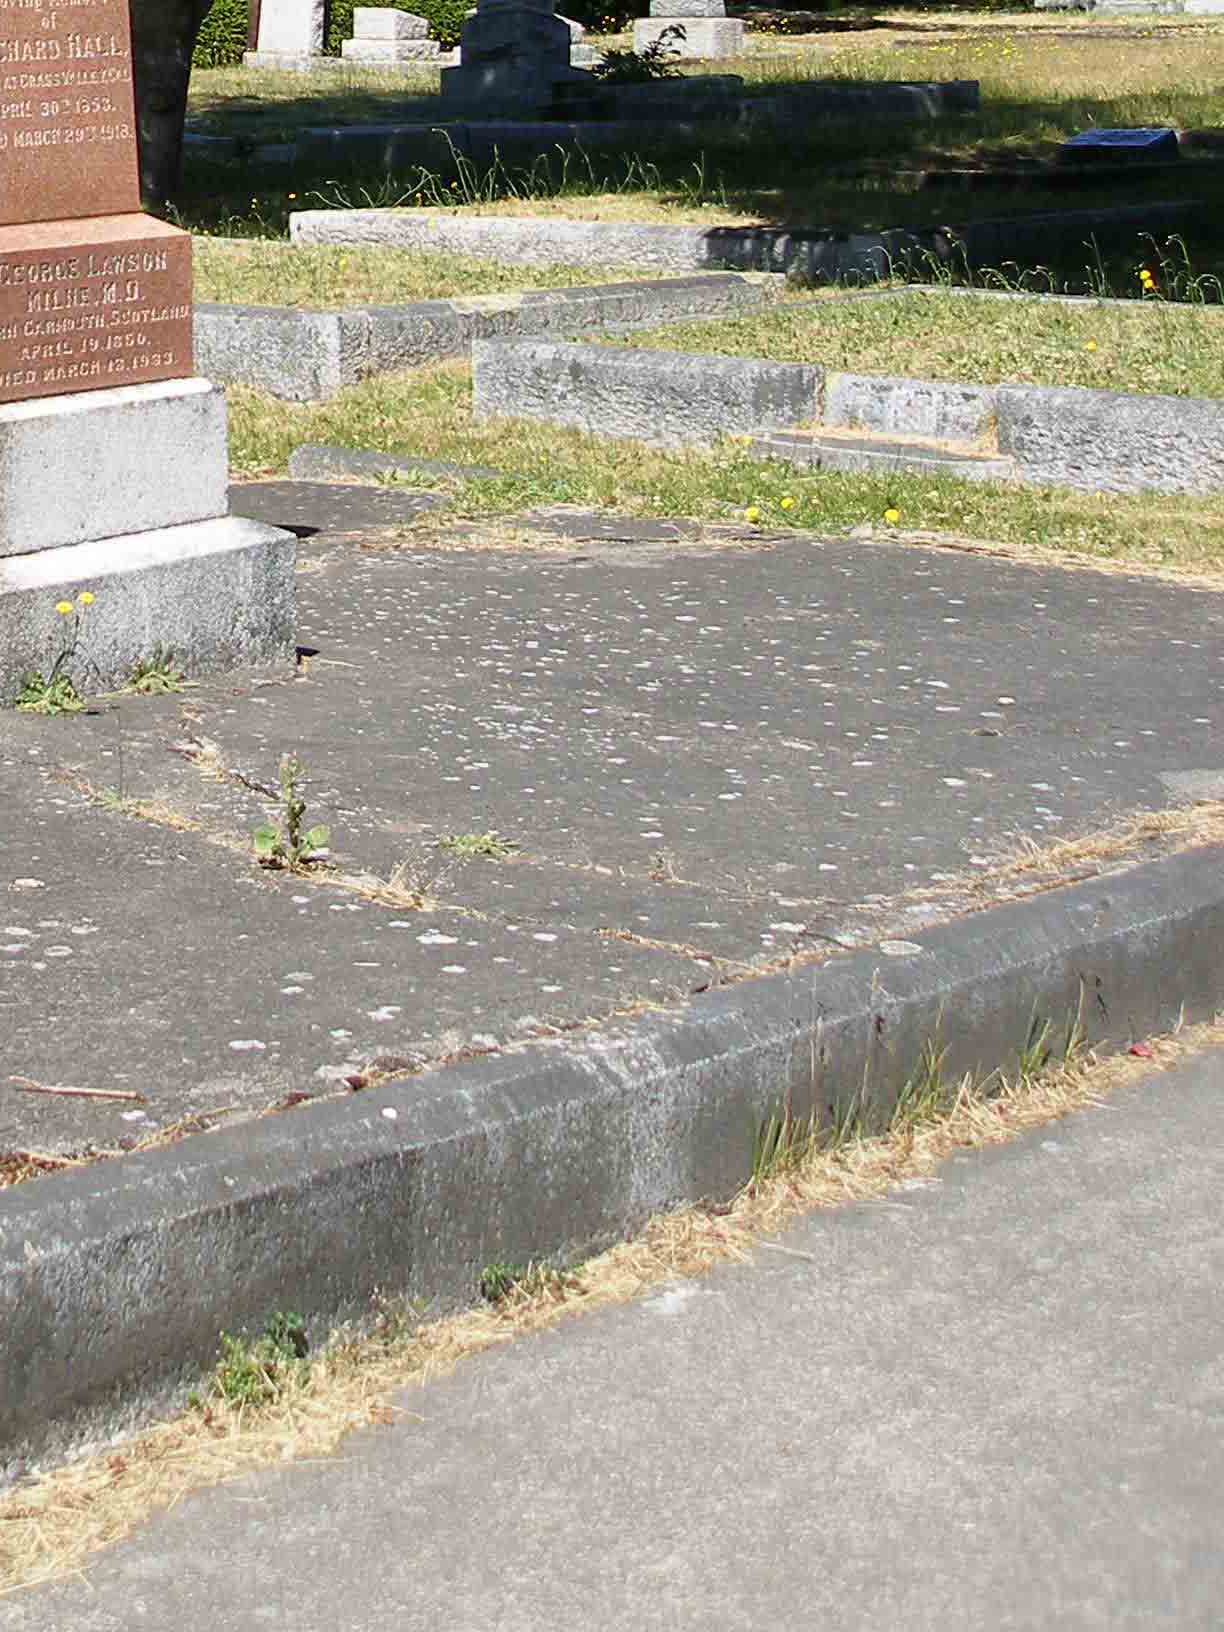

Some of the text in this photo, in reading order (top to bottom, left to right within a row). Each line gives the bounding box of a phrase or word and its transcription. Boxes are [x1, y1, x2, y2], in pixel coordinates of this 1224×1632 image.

[40, 12, 57, 30] of
[13, 127, 62, 148] MARCH
[87, 249, 169, 279] LAWSON
[16, 341, 74, 361] APRIL
[42, 360, 100, 382] MARCH
